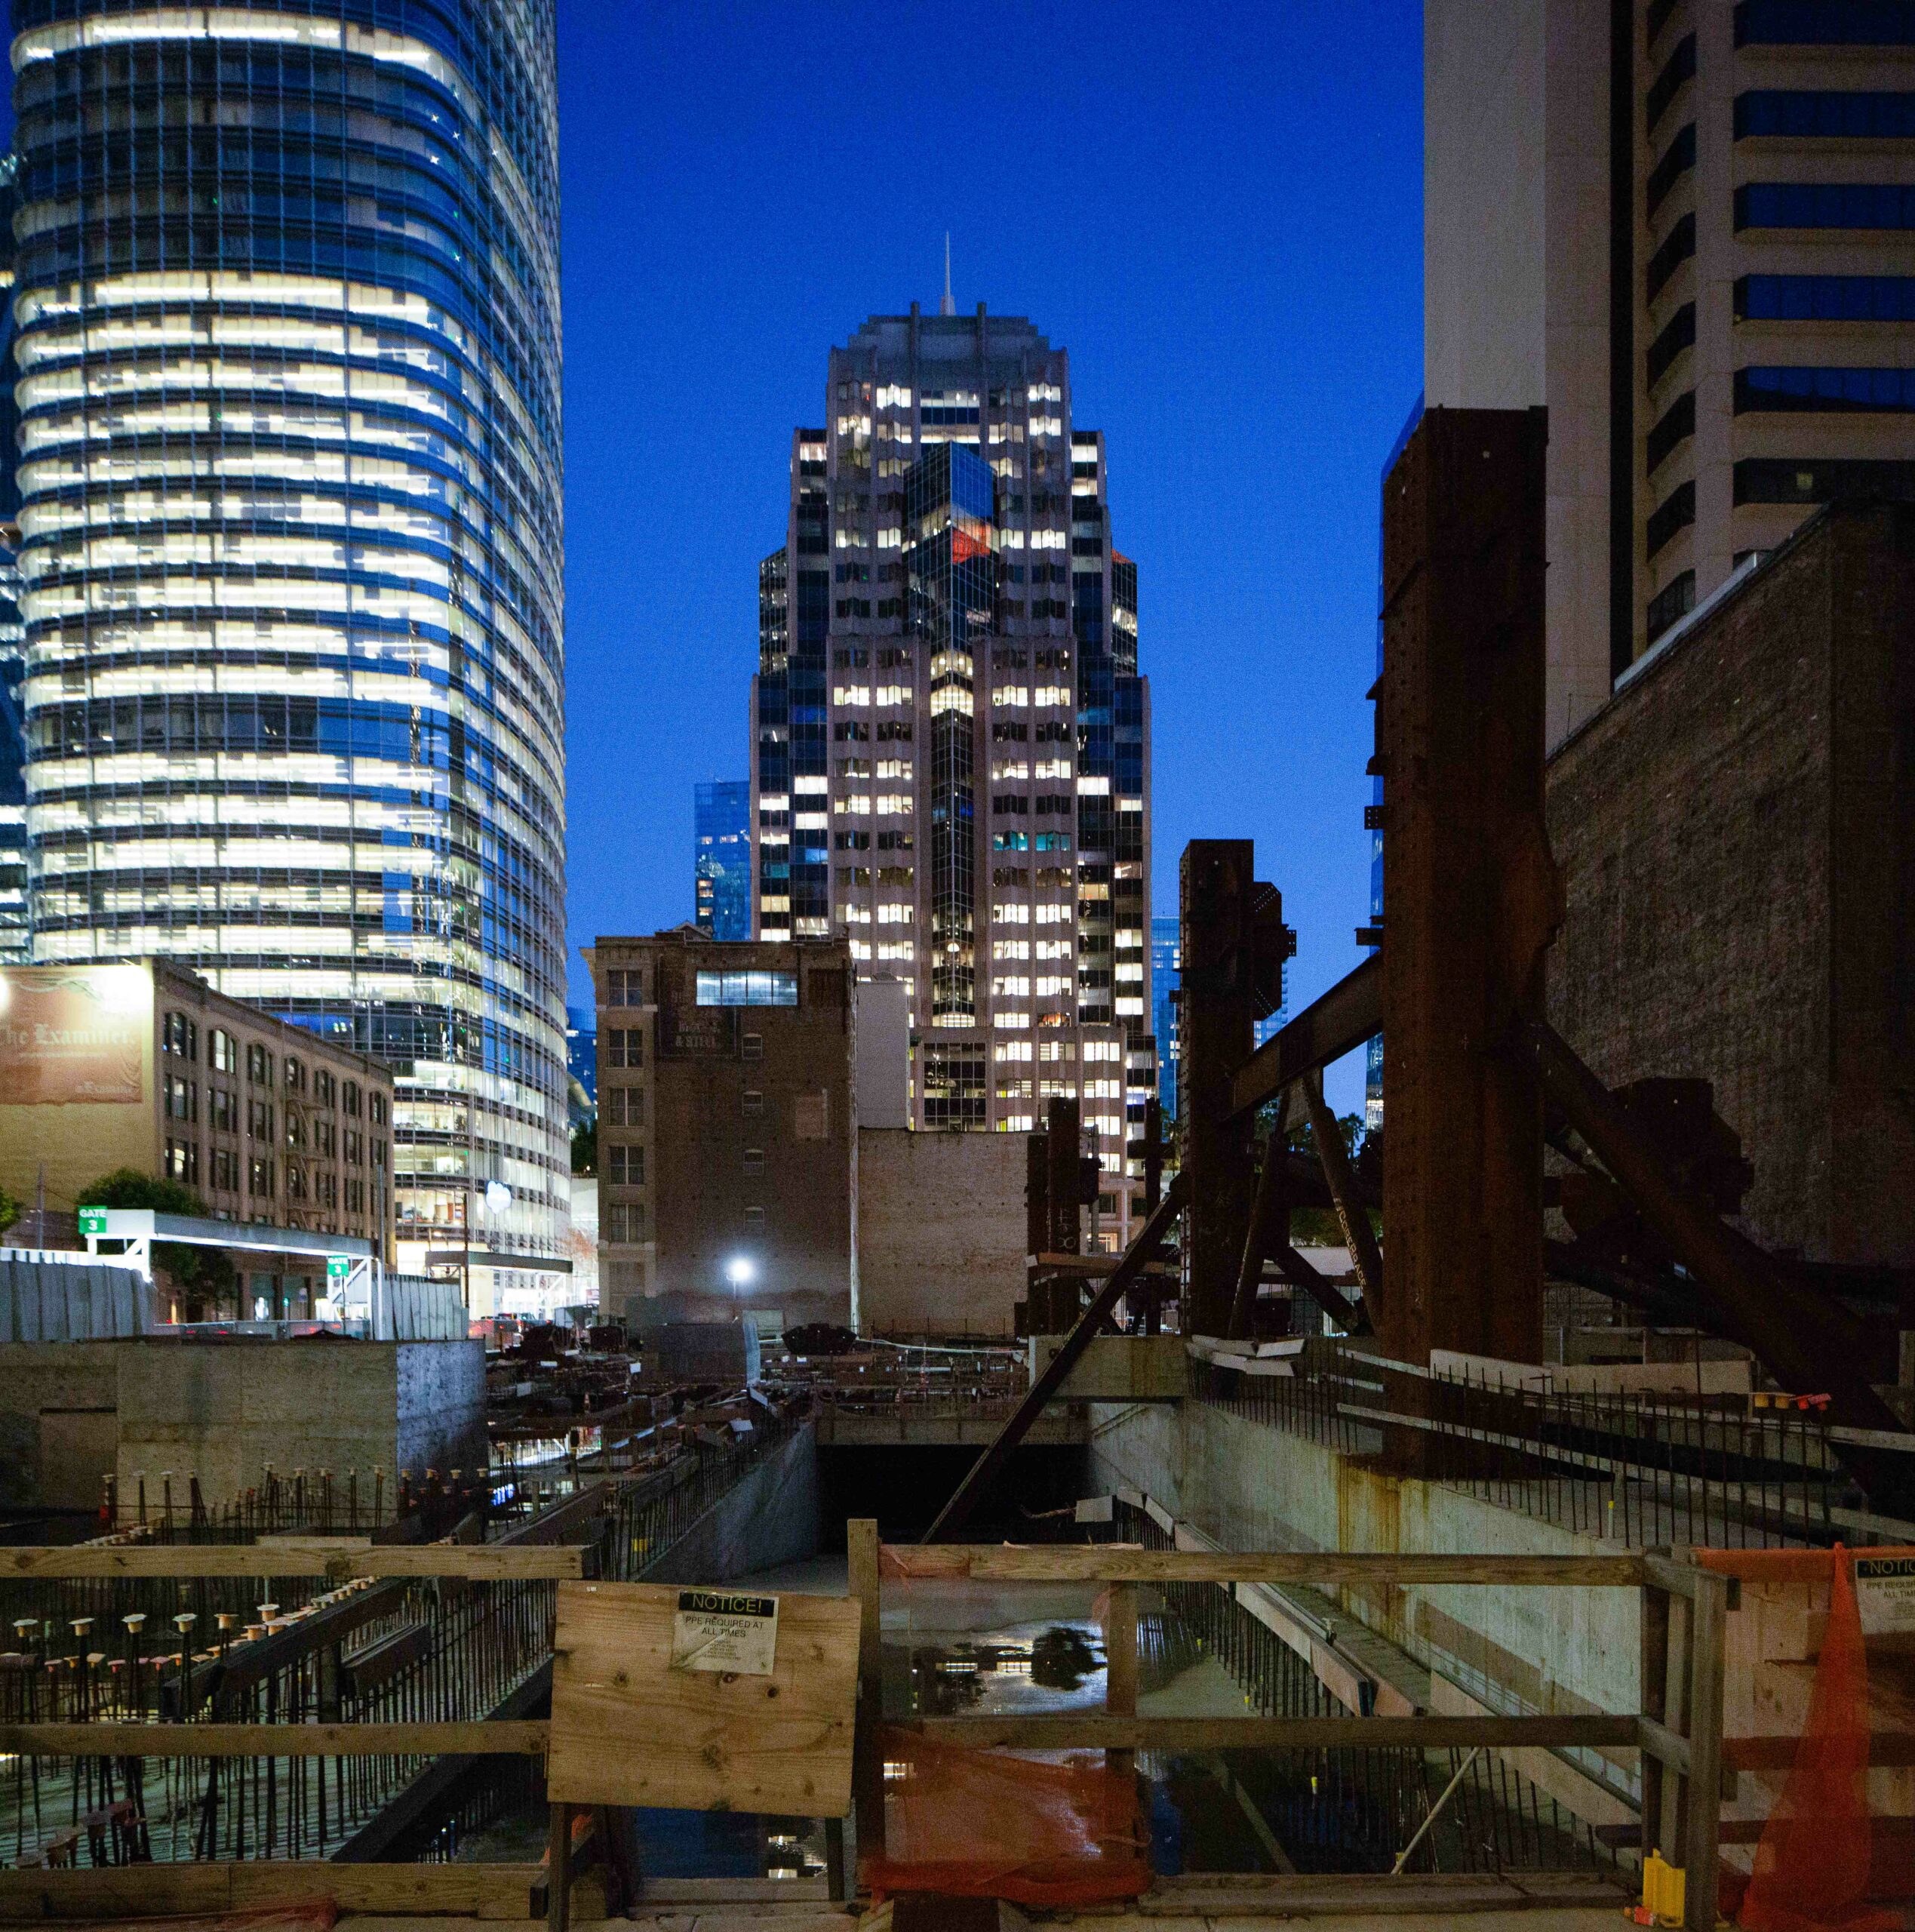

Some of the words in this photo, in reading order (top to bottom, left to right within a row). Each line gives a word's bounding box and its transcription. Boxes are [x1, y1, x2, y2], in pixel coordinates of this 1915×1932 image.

[79, 1209, 107, 1218] GATE
[88, 1220, 98, 1231] 3
[692, 1594, 762, 1613] NOTICE!
[685, 1616, 702, 1625] PPE
[705, 1617, 751, 1628] REQUIRED
[753, 1621, 764, 1629] AT
[702, 1627, 718, 1635] ALL
[721, 1628, 746, 1638] TIMES
